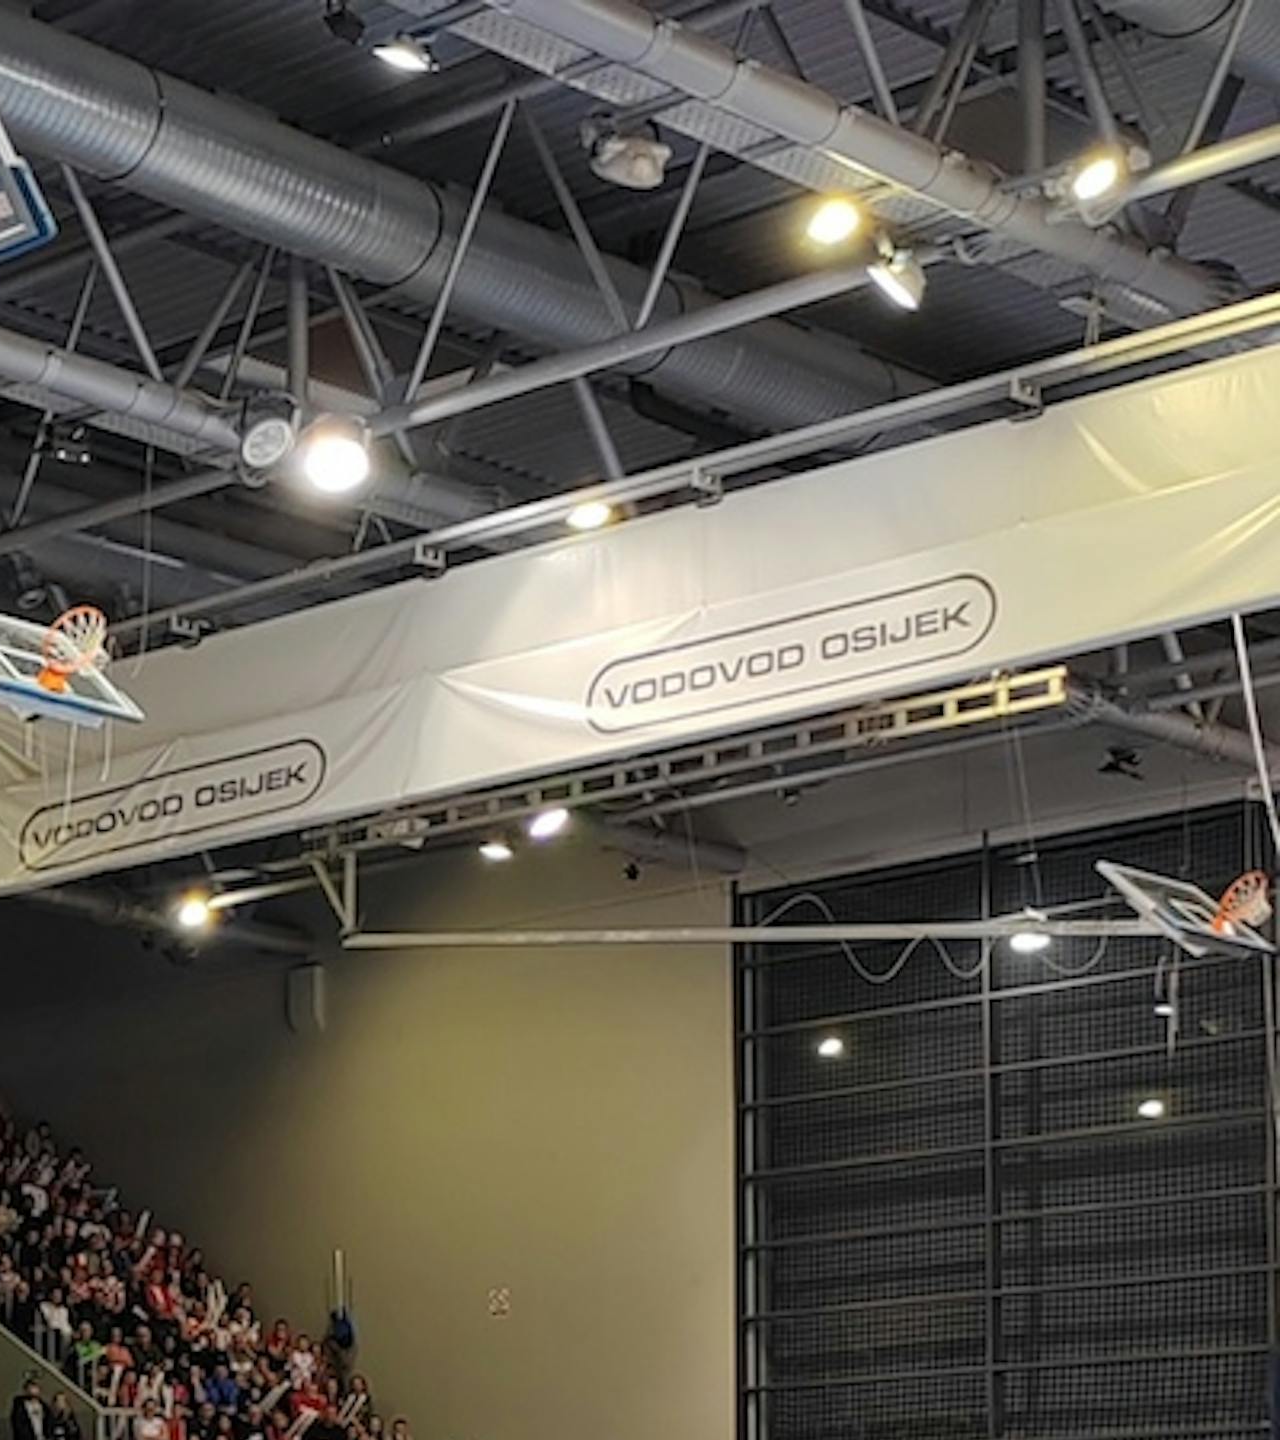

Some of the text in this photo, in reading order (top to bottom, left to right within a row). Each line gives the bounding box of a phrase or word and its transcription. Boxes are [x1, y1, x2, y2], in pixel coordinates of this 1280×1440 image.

[603, 601, 972, 711] VODOVOD OSIJEK
[30, 760, 309, 850] VODOVOD OSIJEK
